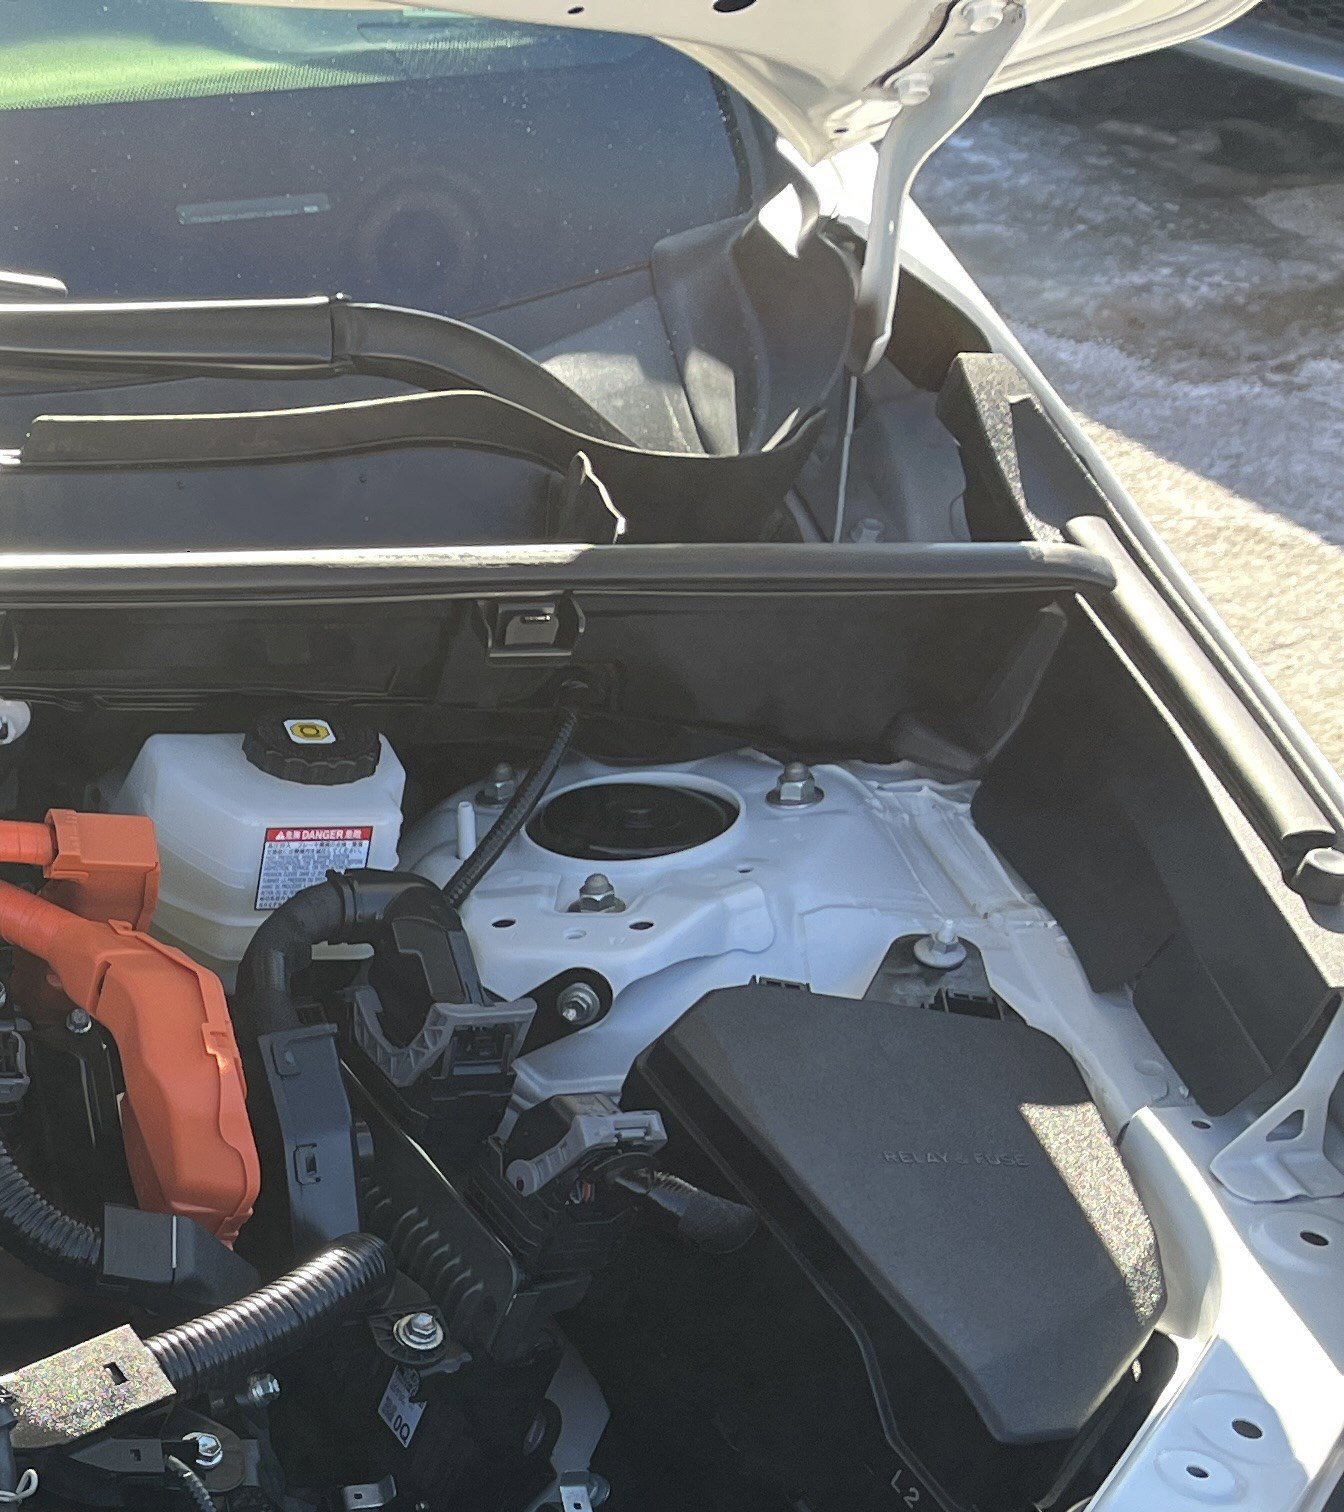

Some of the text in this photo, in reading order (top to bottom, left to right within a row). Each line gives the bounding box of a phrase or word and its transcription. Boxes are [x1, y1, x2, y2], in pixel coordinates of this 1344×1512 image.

[302, 829, 344, 840] DANGER
[882, 1151, 948, 1164] RELAY
[973, 1151, 1031, 1168] FUSE
